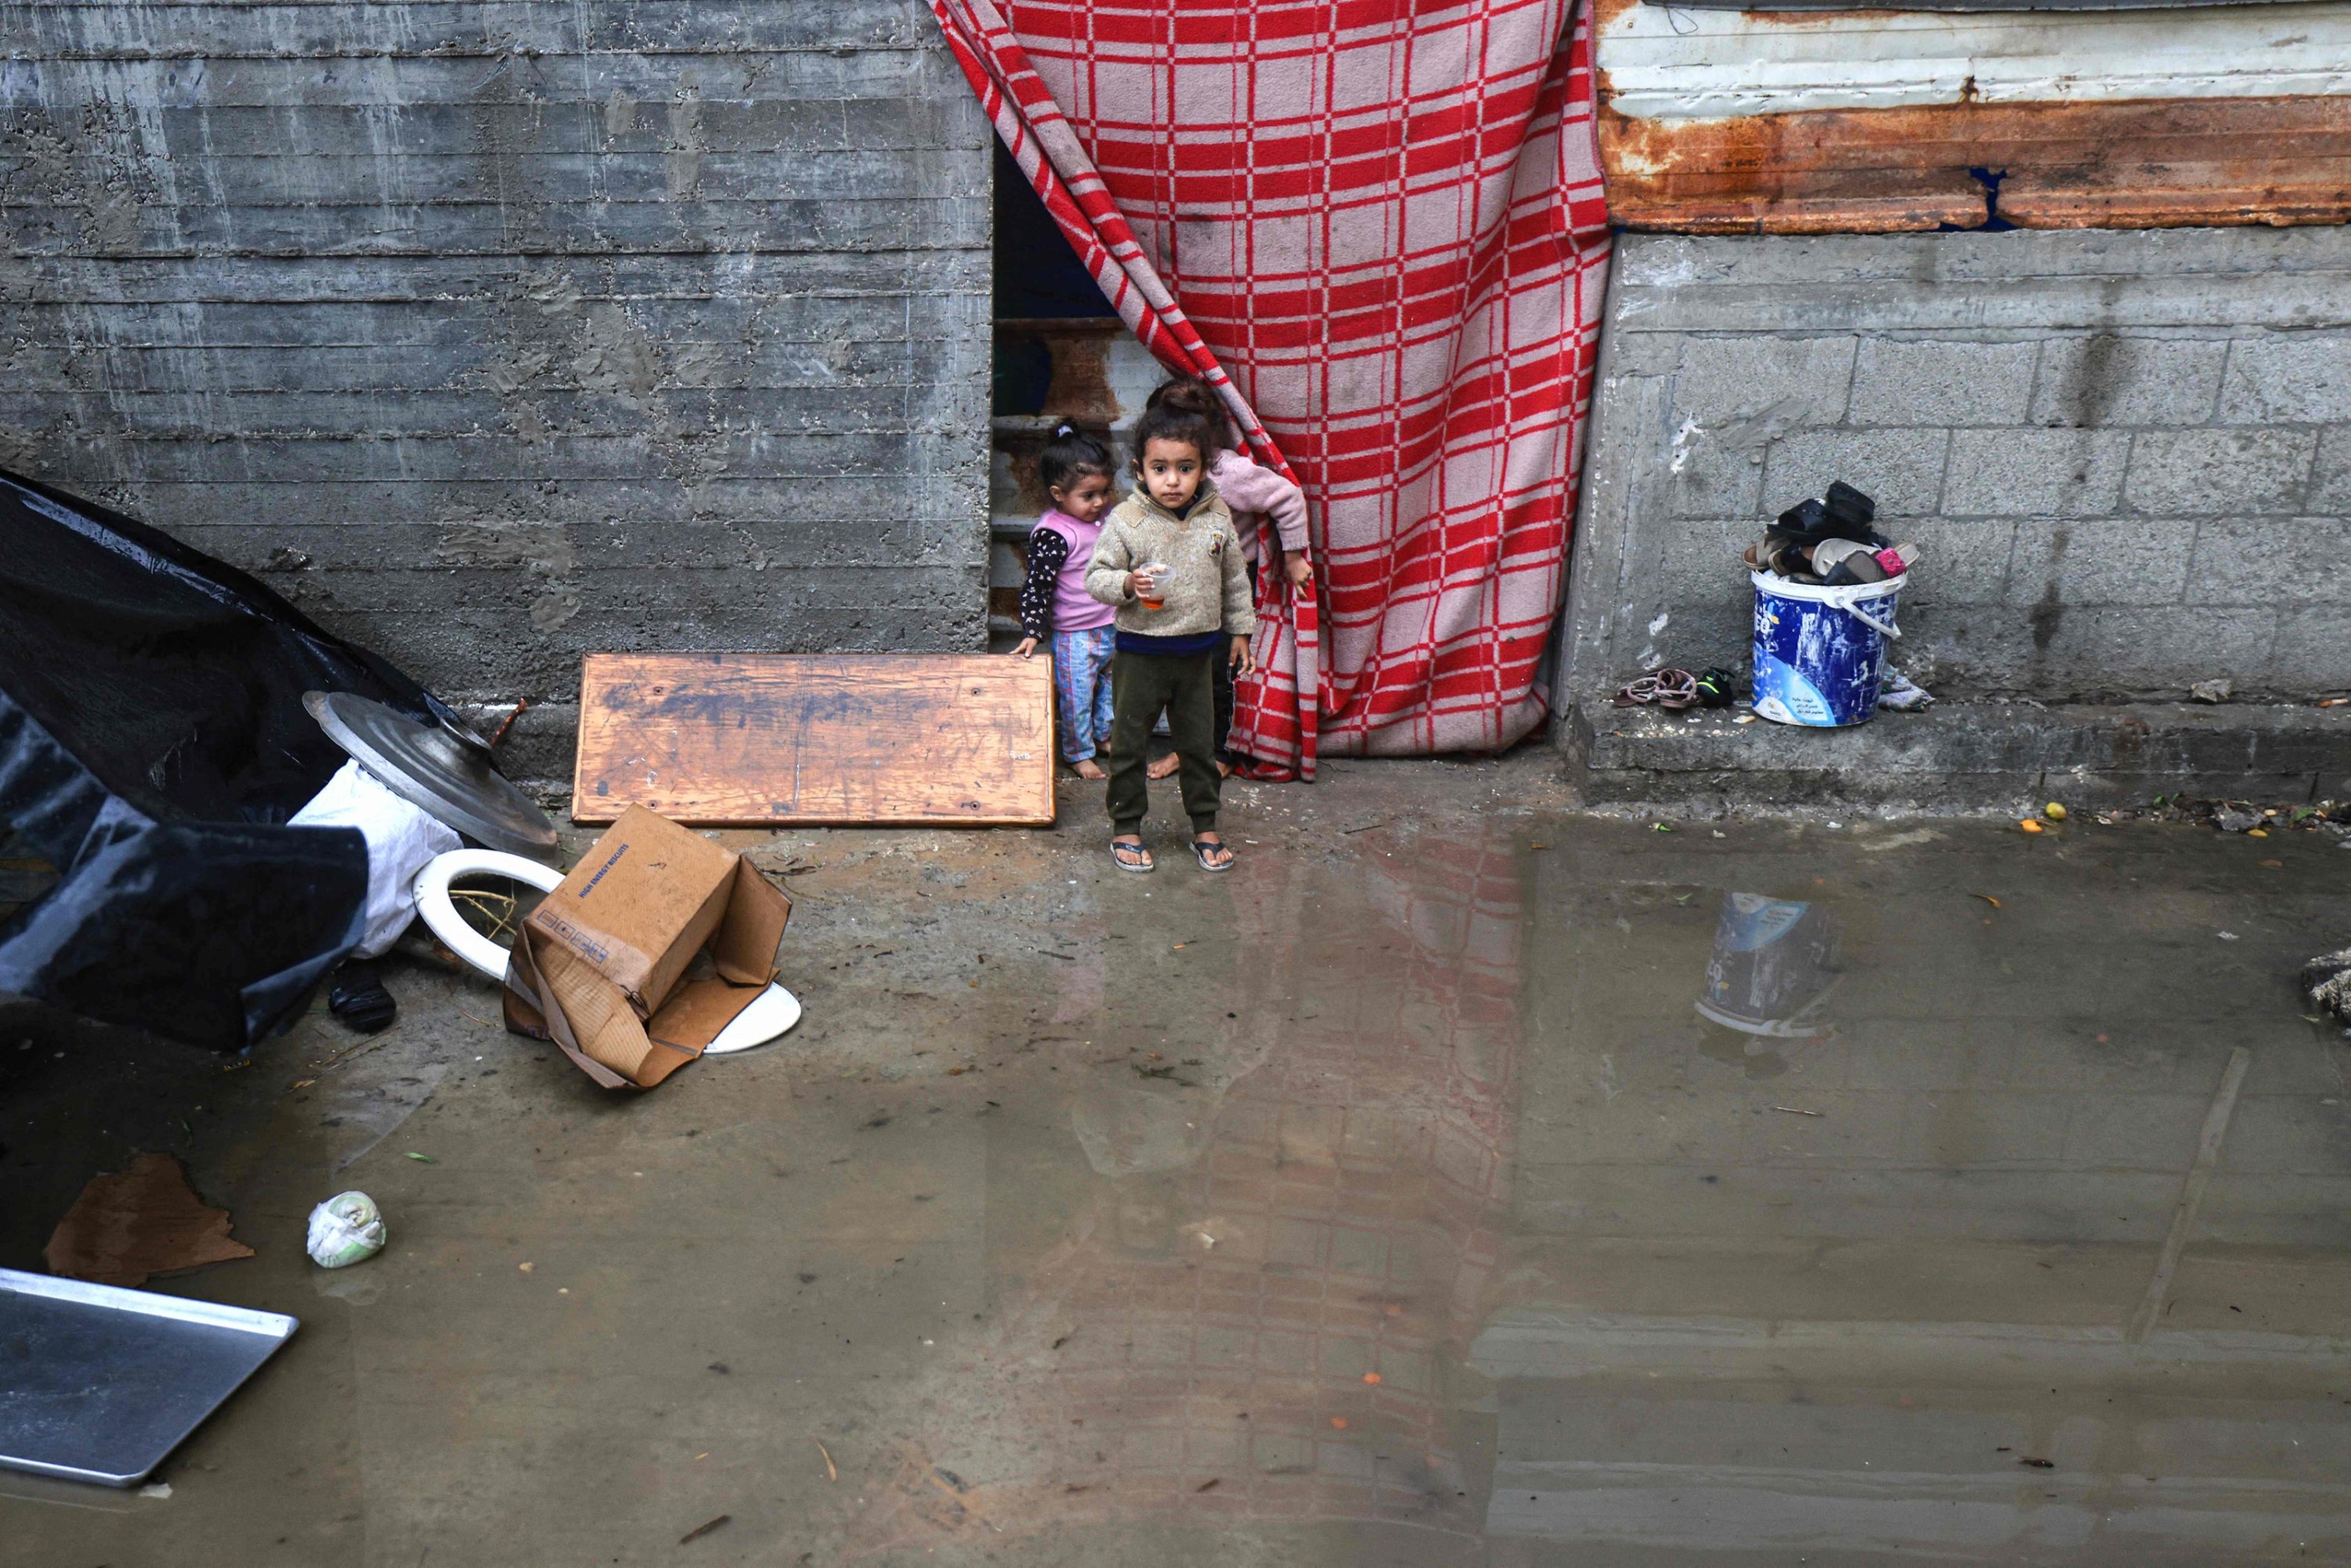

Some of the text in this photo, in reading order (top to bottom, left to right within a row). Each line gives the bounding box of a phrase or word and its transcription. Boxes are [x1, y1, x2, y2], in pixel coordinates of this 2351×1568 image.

[578, 843, 629, 898] HIGH ENERGY BISCUITS
